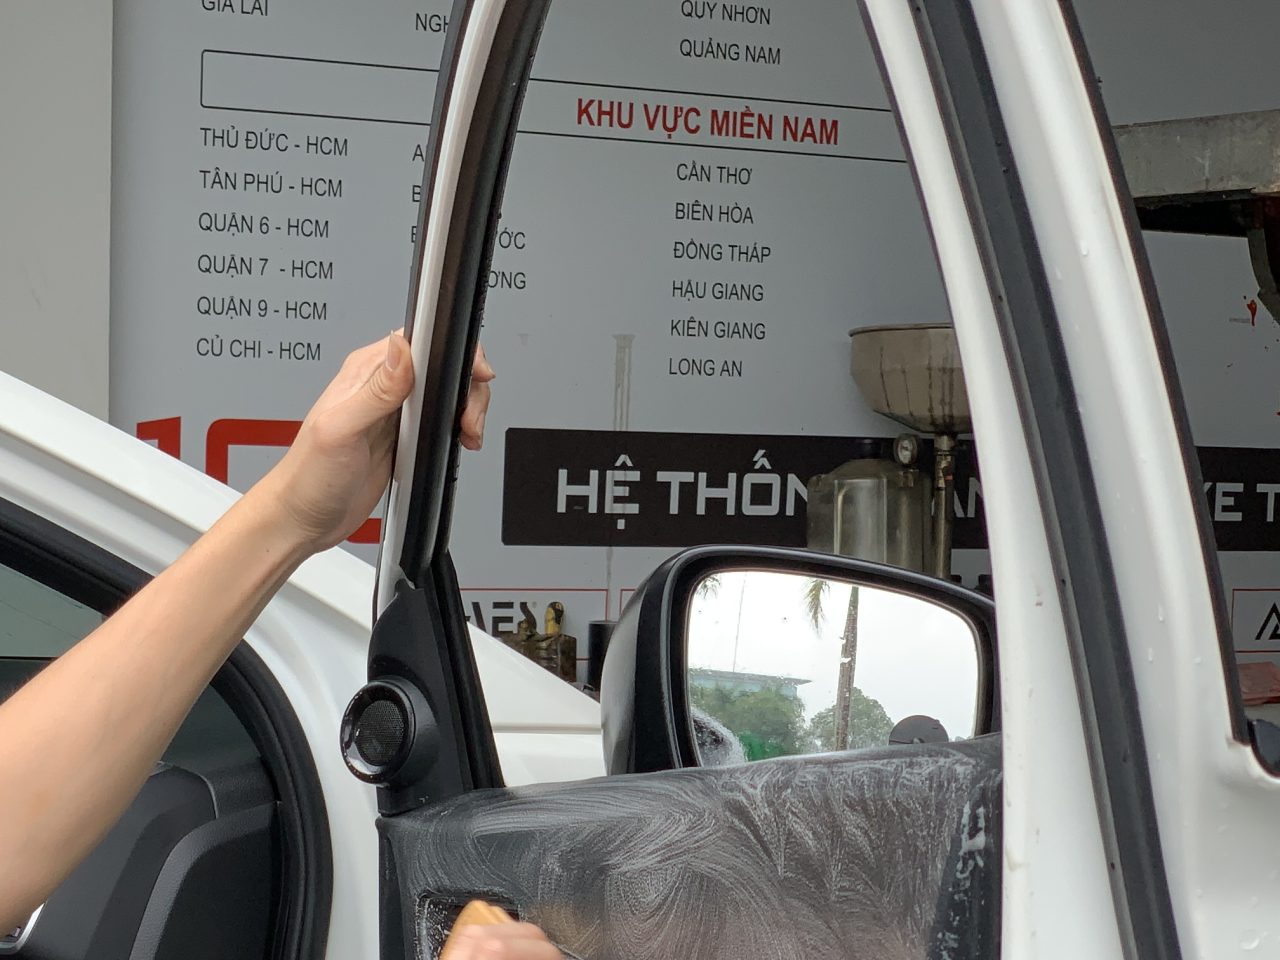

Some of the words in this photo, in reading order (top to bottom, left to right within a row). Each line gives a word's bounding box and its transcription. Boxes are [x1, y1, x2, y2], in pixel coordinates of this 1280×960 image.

[201, 0, 235, 14] GIA
[241, 0, 268, 16] LAI
[722, 3, 771, 25] NHƠN
[680, 37, 740, 61] QUẢNG
[745, 44, 781, 65] NAM
[577, 98, 634, 129] KHU
[643, 103, 701, 139] VỰC
[710, 105, 773, 140] MIỀN
[782, 115, 839, 146] NAM
[200, 125, 239, 149] THỦ
[245, 127, 289, 152] ĐỨC
[306, 135, 348, 157] HCM
[199, 166, 237, 190] TÂN
[244, 171, 283, 194] PHÚ
[301, 176, 342, 198] HCM
[677, 160, 711, 182] CẦN
[716, 166, 753, 185] THƠ
[675, 200, 713, 221] BIÊN
[718, 202, 754, 224] HÒA
[198, 212, 253, 236] QUẬN
[259, 216, 270, 235] 6
[287, 218, 329, 238] HCM
[673, 238, 723, 261] ĐỒNG
[728, 242, 771, 263] THÁP
[197, 254, 253, 278] QUẬN
[259, 257, 269, 276] 7
[291, 259, 333, 280] HCM
[672, 279, 707, 301] HẬU
[711, 282, 764, 302] GIANG
[197, 296, 252, 320] QUẬN
[257, 299, 268, 318] 9
[285, 301, 327, 321] HCM
[670, 316, 708, 337] KIÊN
[714, 321, 766, 340] GIANG
[196, 335, 223, 357] CỦ
[230, 339, 261, 358] CHI
[279, 341, 321, 361] HCM
[669, 357, 715, 377] LONG
[719, 359, 742, 377] AN
[556, 454, 641, 530] HỆ
[656, 449, 808, 516] THỐN
